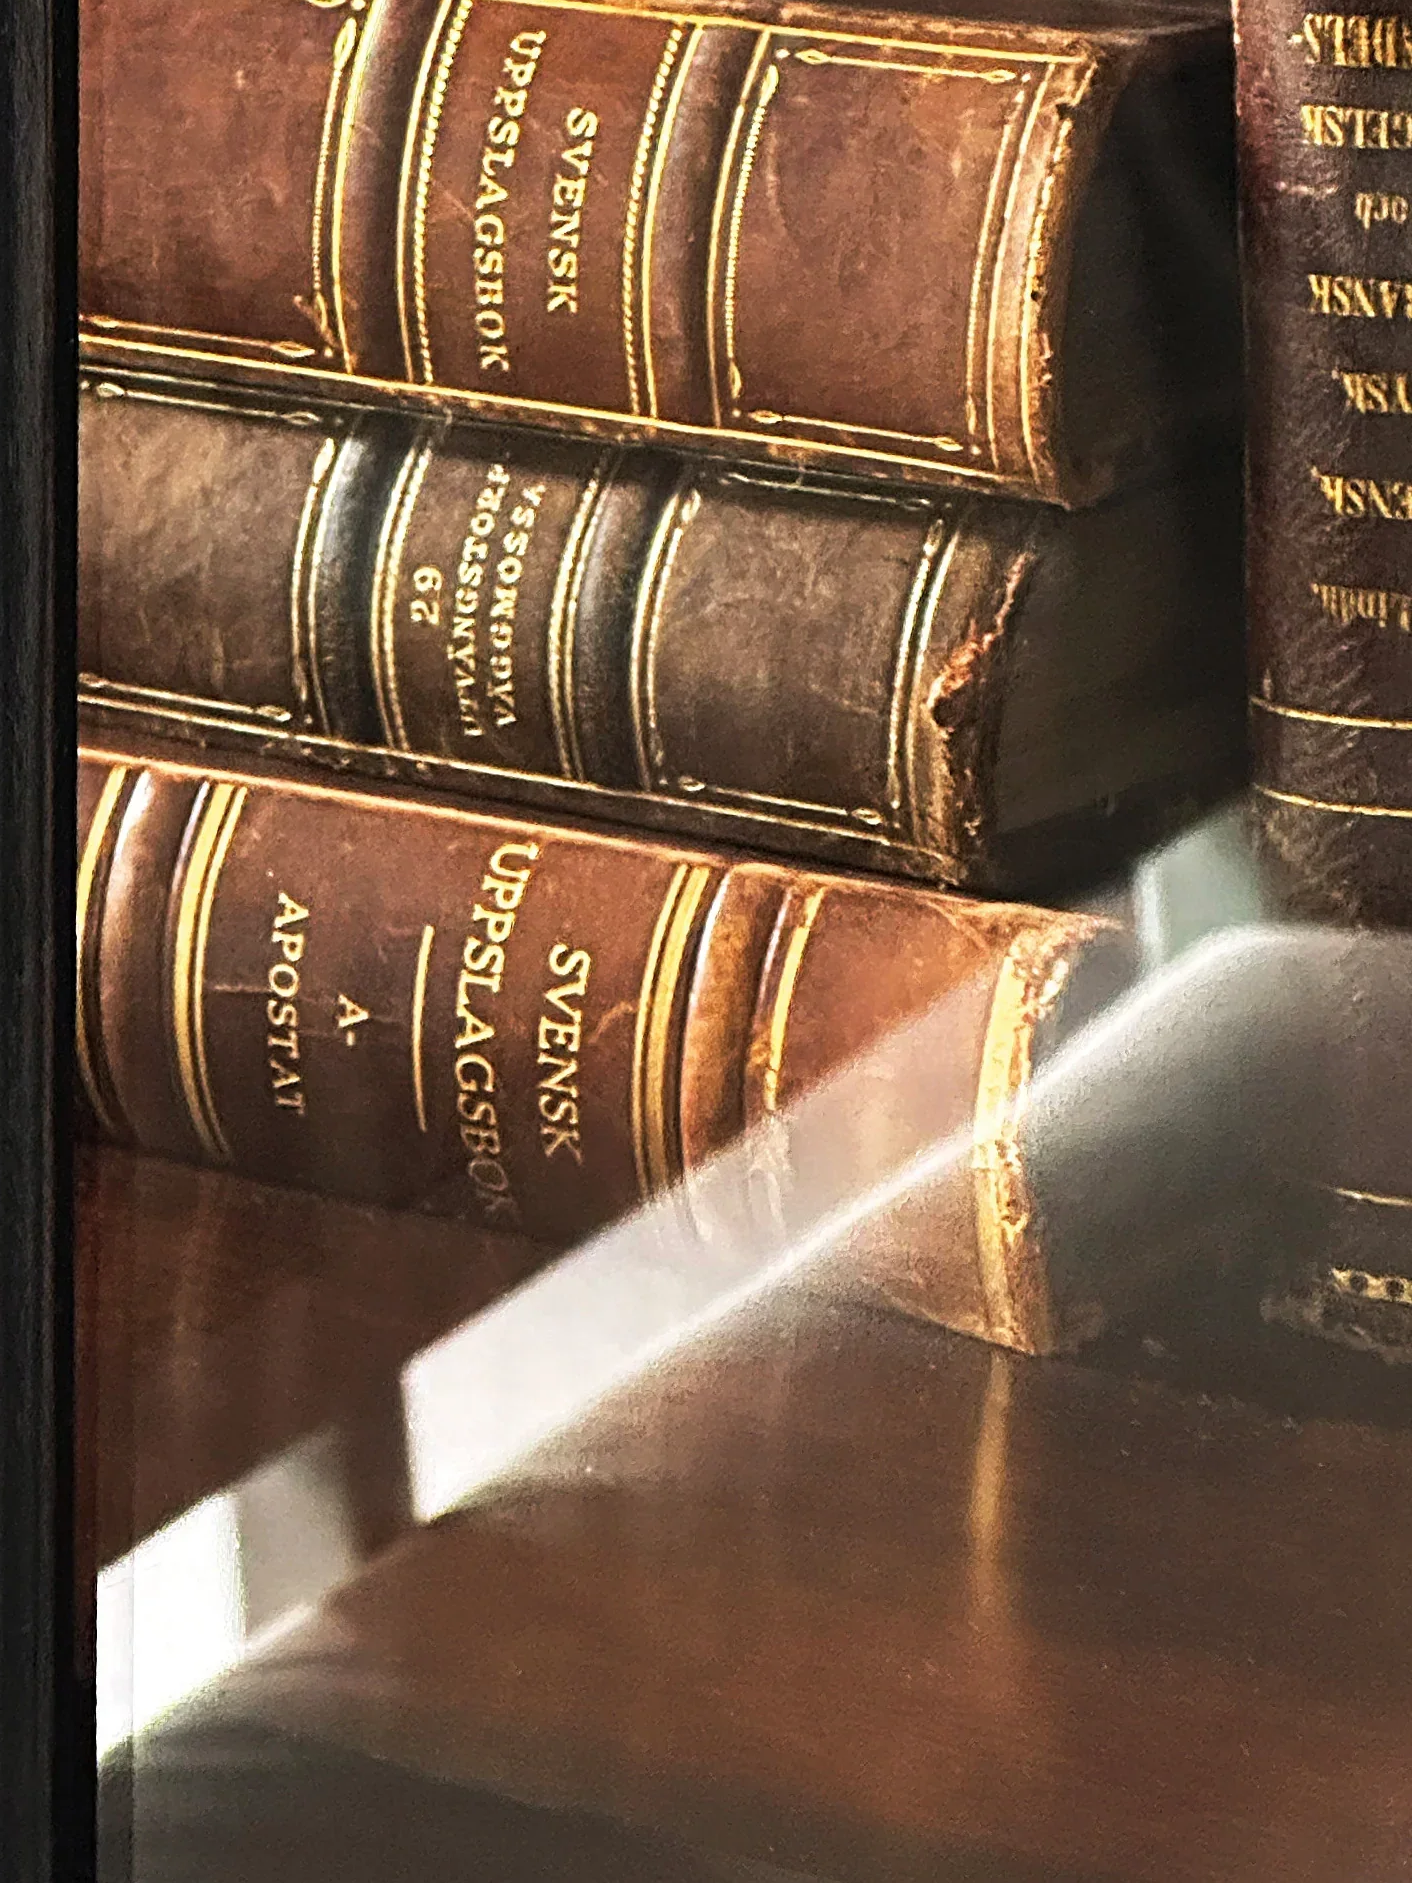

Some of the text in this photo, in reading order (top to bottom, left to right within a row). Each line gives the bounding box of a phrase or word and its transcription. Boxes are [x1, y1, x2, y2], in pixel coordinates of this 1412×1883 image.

[473, 29, 548, 372] UPPSLAGSBOK
[547, 106, 599, 314] SVENSK
[410, 566, 442, 625] 29
[487, 484, 546, 725] VÄGGMOSSA
[267, 891, 310, 1116] APOSTAT
[337, 994, 370, 1047] A-
[537, 943, 592, 1165] SVENSK
